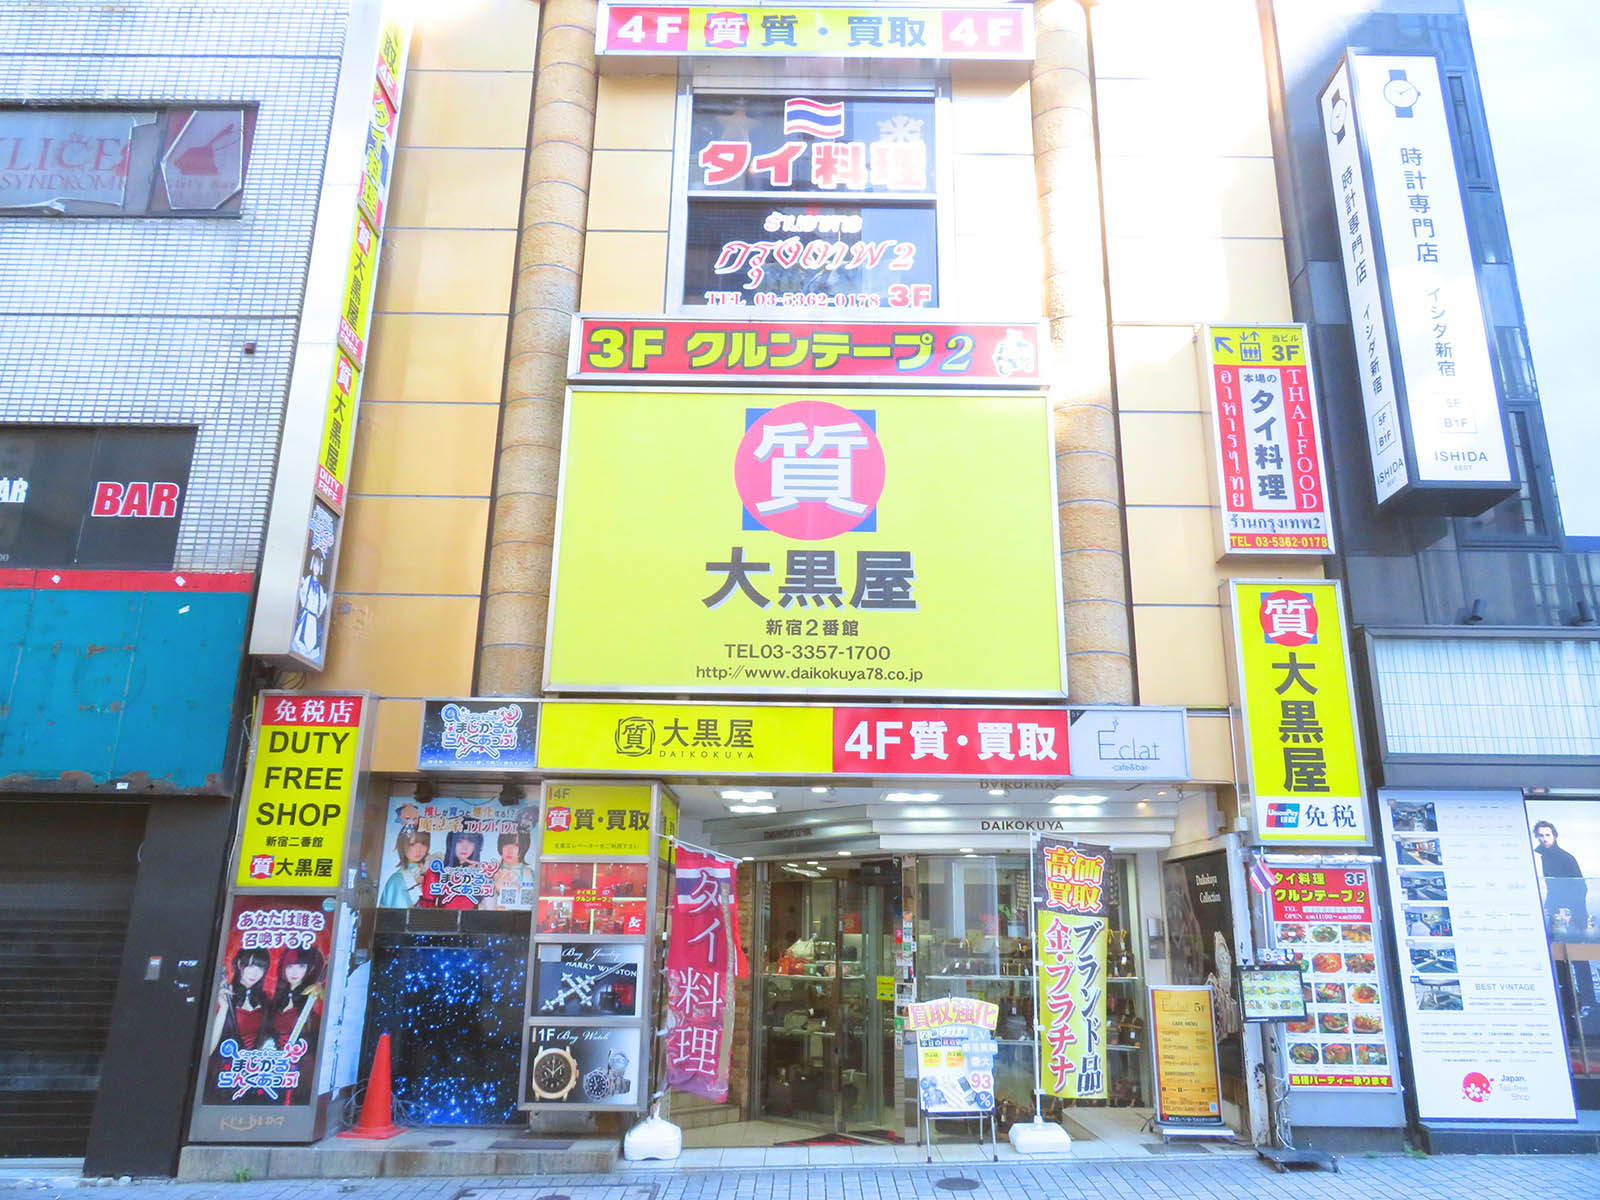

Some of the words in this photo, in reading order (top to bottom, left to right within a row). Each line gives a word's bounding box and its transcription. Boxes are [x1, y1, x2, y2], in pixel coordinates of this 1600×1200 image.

[618, 16, 682, 44] 4F
[708, 19, 748, 45] 質
[761, 15, 926, 47] 質・買取
[950, 18, 1013, 42] 4F
[699, 141, 926, 190] タイ料理
[1400, 148, 1439, 264] 時計専門店
[1341, 165, 1369, 287] 時計専門店
[891, 241, 916, 271] 2
[705, 291, 746, 307] TEL
[755, 292, 880, 308] 03-5362-0178
[887, 285, 932, 308] 3F
[341, 318, 360, 347] DUTY
[1427, 287, 1456, 377] イシダ新宿
[586, 328, 667, 369] 3F
[686, 331, 935, 370] クルンテープ
[939, 334, 975, 373] 2
[1271, 344, 1300, 362] 3F
[1363, 303, 1383, 395] イシダ新宿
[1243, 373, 1278, 385] 本場の
[1444, 418, 1469, 428] B1F
[1250, 389, 1288, 500] タイ料理
[1434, 451, 1489, 462] ISHIDA
[319, 467, 341, 493] DUTY
[753, 421, 869, 516] 質
[1376, 457, 1404, 485] ISHIDA
[91, 481, 181, 518] BAR
[1230, 535, 1251, 548] TEL
[1255, 535, 1329, 549] 03-5362-0178
[702, 546, 920, 612] 大黒屋
[765, 618, 859, 638] 新宿2番館
[1264, 598, 1316, 639] 質
[724, 644, 892, 661] TEL03-3357-1700
[696, 664, 924, 683] http://www.daikokuya78.co.jp
[273, 699, 355, 723] 免税店
[1272, 652, 1330, 793] 大黒屋
[269, 731, 350, 754] DUTY
[662, 718, 754, 748] 大黒屋
[659, 750, 754, 759] DAIKOKUYA
[264, 767, 344, 790] FREE
[553, 788, 571, 799] 4F
[256, 803, 341, 826] SHOP
[574, 808, 650, 831] 質・買取
[980, 820, 1065, 831] DAIKOKUYA
[1304, 804, 1358, 829] 免税
[265, 836, 324, 848] 新宿二番館
[251, 857, 274, 876] 質
[275, 858, 333, 877] 大黒屋
[1044, 846, 1106, 885] 高価
[1345, 873, 1365, 886] 3F
[1046, 880, 1103, 913] 買取
[1274, 889, 1354, 903] クルンテープ
[1355, 892, 1366, 903] 2
[237, 910, 326, 931] あなたは誰を
[672, 870, 724, 1077] タイ料理
[1500, 983, 1536, 991] VINTAGE
[1044, 918, 1077, 1094] 金・プラチナ
[1073, 920, 1103, 1098] ブランド品
[538, 1028, 555, 1041] 1F
[970, 1073, 992, 1089] 93
